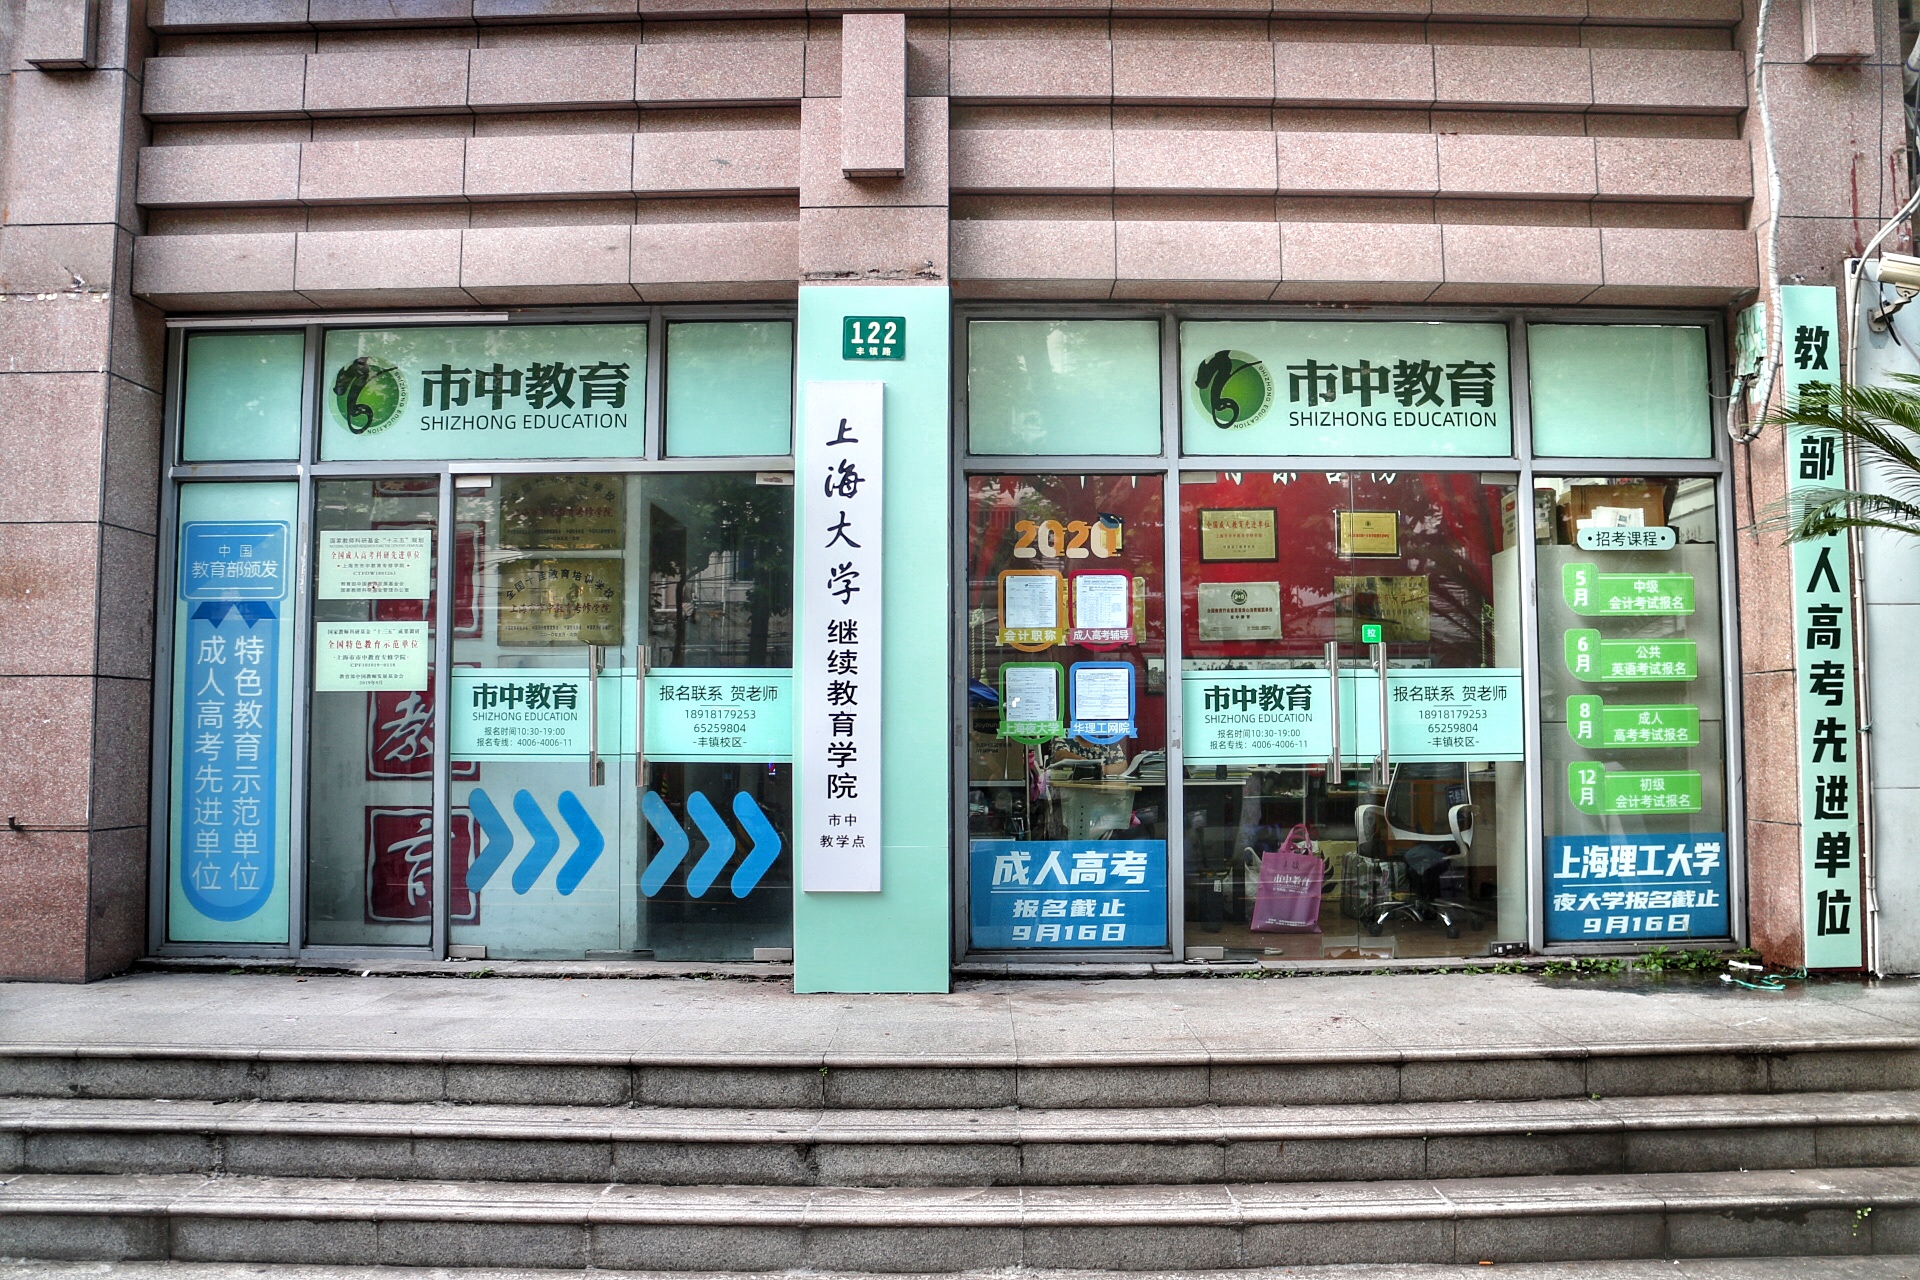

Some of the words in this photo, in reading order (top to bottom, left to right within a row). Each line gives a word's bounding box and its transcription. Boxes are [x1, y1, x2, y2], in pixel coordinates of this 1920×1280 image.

[850, 321, 897, 344] 122
[855, 347, 892, 357] 丰镇路
[421, 360, 630, 411] 市中教育
[1286, 358, 1496, 408] 市中教育
[421, 413, 516, 431] SHIZHONG
[523, 412, 628, 430] EDUCATION
[1233, 404, 1269, 429] EDUCATION
[1289, 411, 1387, 427] SHIZHONG
[1394, 411, 1497, 427] EDUCATION
[1013, 519, 1119, 559] 2020
[1595, 531, 1659, 547] 招考课程
[218, 544, 253, 558] 中国
[331, 551, 420, 560] 全国成人高考科研先进单位
[191, 560, 279, 579] 教育部颁发
[1633, 580, 1659, 593] 中级
[824, 418, 866, 800] 上海大学继续教育学院
[1609, 596, 1684, 610] 会计考试报名
[1003, 630, 1057, 642] 会计职称
[1073, 630, 1130, 641] 成人高考辅导
[1366, 628, 1377, 638] 拉
[328, 639, 419, 649] 全国特色教育示范单位
[1635, 645, 1661, 659] 公共
[1611, 662, 1687, 676] 英语考试报名
[472, 683, 578, 710] 市中教育
[659, 685, 723, 702] 报名联系
[730, 685, 778, 702] 贺老师
[1203, 683, 1312, 712] 市中教育
[1393, 685, 1456, 702] 报名联系
[1462, 685, 1507, 702] 贺老师
[472, 711, 522, 721] SHIZHONG
[524, 711, 578, 721] EDUCATION
[684, 709, 756, 719] 18918179253
[1204, 713, 1256, 724] SHIZHONG
[1258, 712, 1313, 723] EDUCATION
[1418, 709, 1488, 719] 18918179253
[1638, 711, 1664, 725] 成人
[484, 726, 566, 736] 报名时间10:30-19:00
[693, 723, 746, 733] 65259804
[974, 721, 999, 731] Joyoun
[1002, 722, 1060, 735] 上海夜大学
[1073, 722, 1131, 734] 华理工网院
[1427, 723, 1479, 733] 65259804
[1217, 728, 1301, 739] 报名时间10:30-19:00
[1613, 728, 1689, 742] 高考考试报名
[692, 736, 748, 748] -丰镇校区-
[1427, 736, 1480, 748] -丰镇校区-
[192, 635, 227, 891] 成人高考先进单位
[230, 635, 265, 891] 特色教育示范单位
[1639, 778, 1666, 792] 初级
[1615, 794, 1691, 809] 会计考试报名
[827, 813, 857, 827] 市中
[819, 834, 866, 848] 教学点
[1553, 842, 1721, 879] 上海理工大学
[992, 850, 1148, 886] 成人高考
[1553, 889, 1720, 912] 夜大学报名截止
[1012, 898, 1126, 918] 报名截止
[1583, 914, 1691, 934] 9月16日
[1011, 923, 1127, 943] 9月16日
